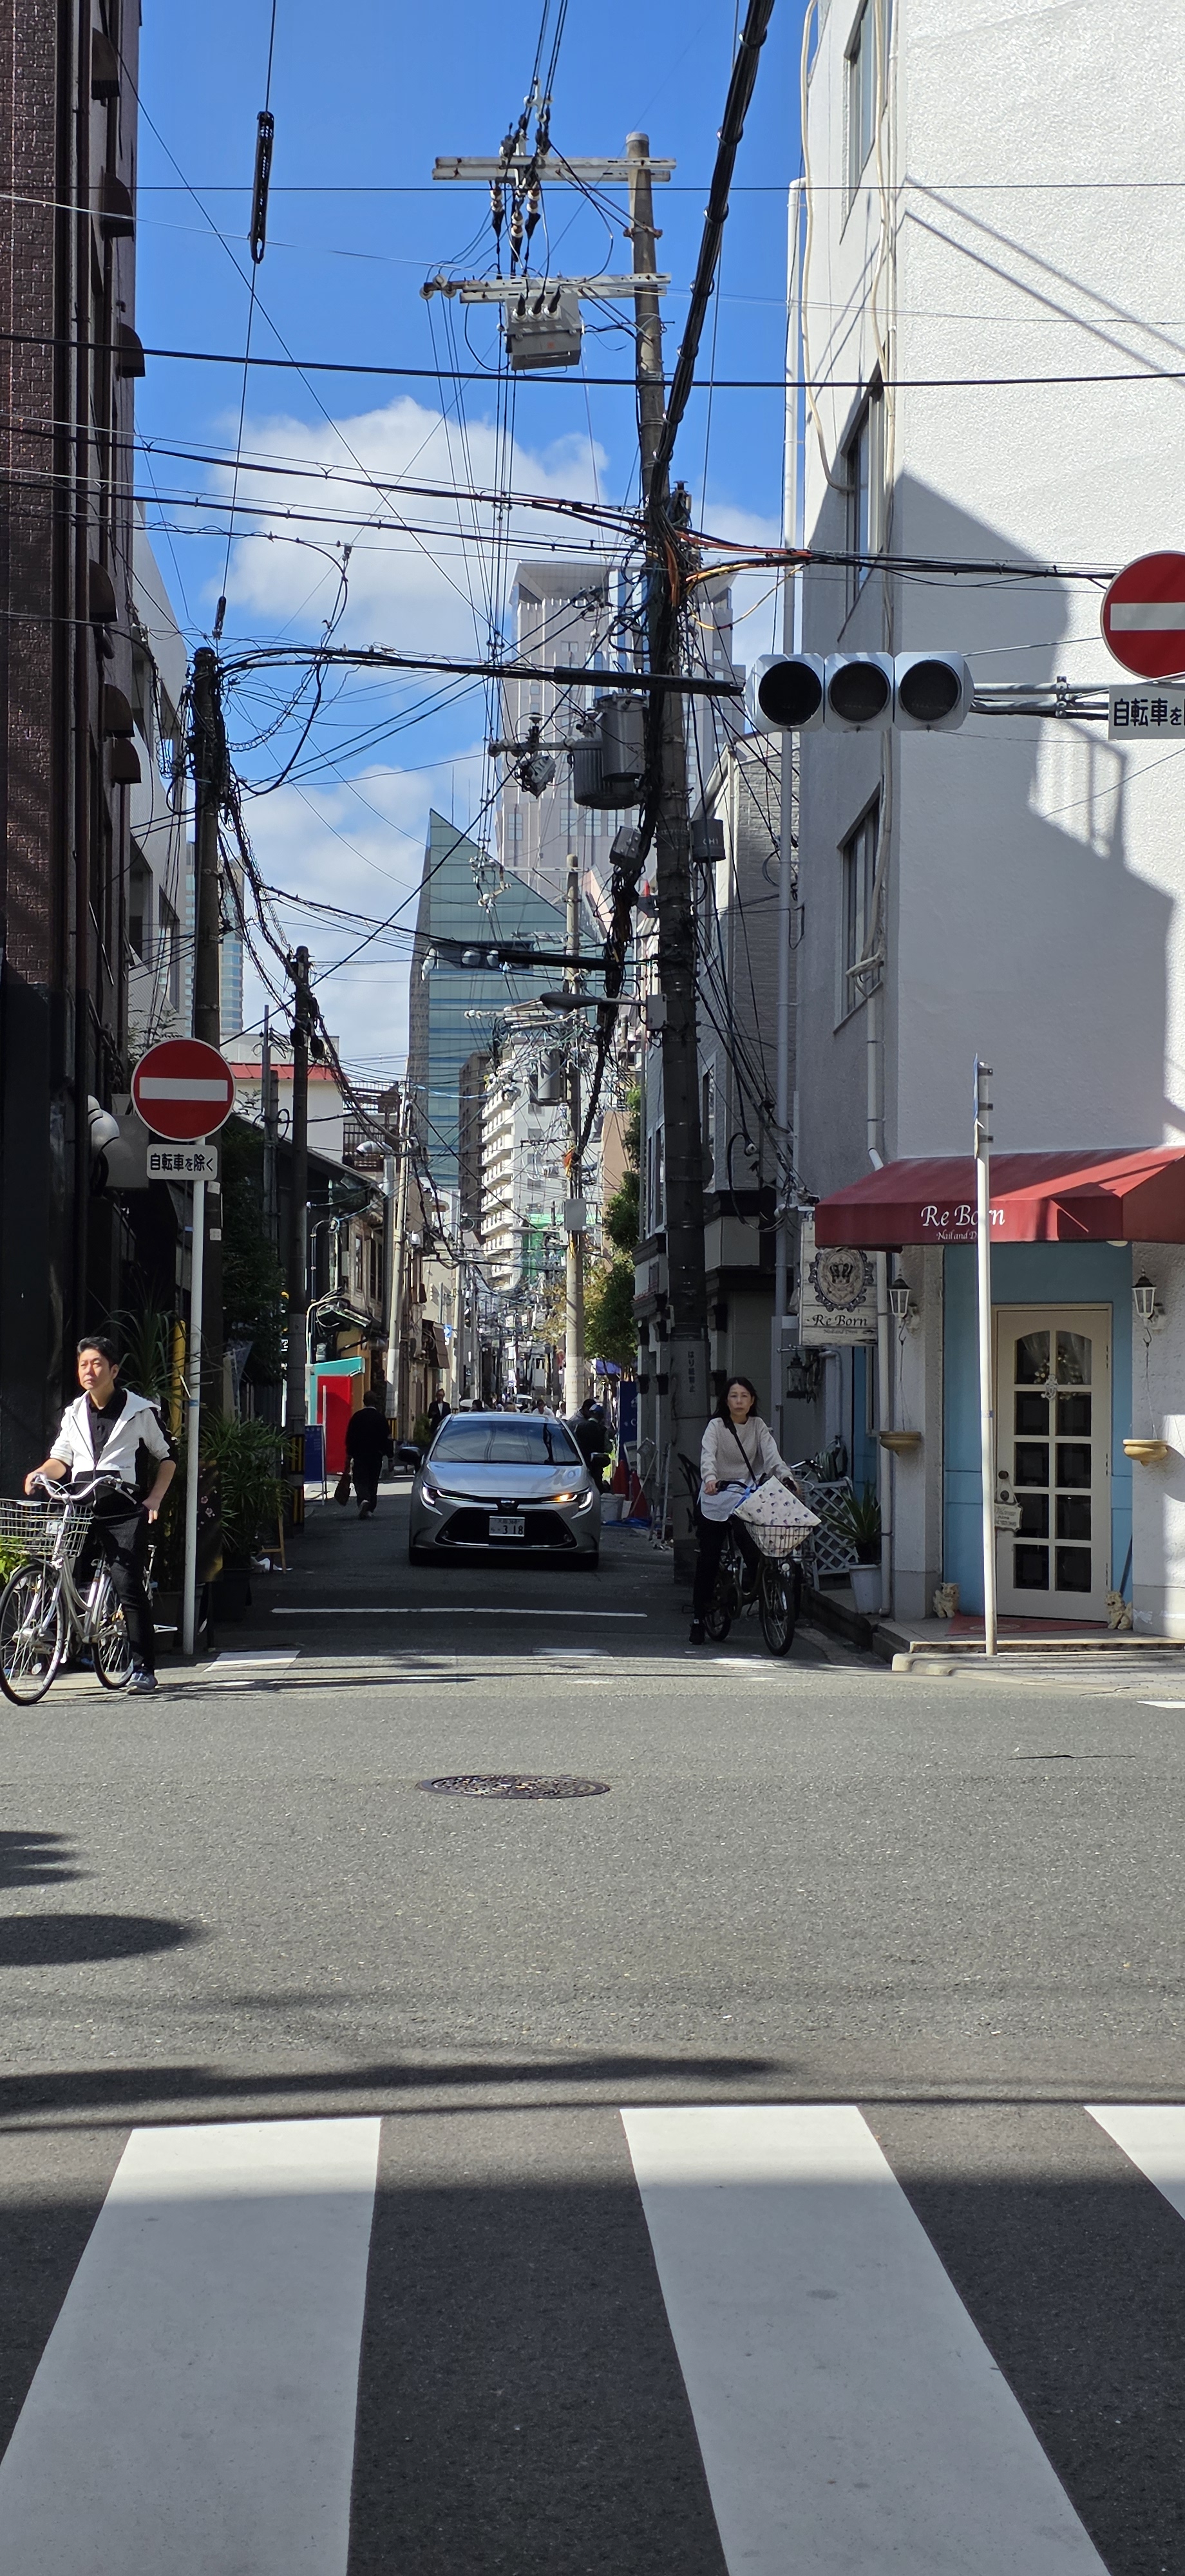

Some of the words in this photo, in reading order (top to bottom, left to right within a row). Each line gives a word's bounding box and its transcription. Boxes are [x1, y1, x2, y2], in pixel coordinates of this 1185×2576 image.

[1114, 697, 1185, 726] 自転車を
[150, 1153, 213, 1171] 自転車を除く
[920, 1205, 949, 1227] Re
[954, 1204, 1005, 1226] Bon
[812, 1314, 832, 1327] Re
[835, 1314, 867, 1327] Born
